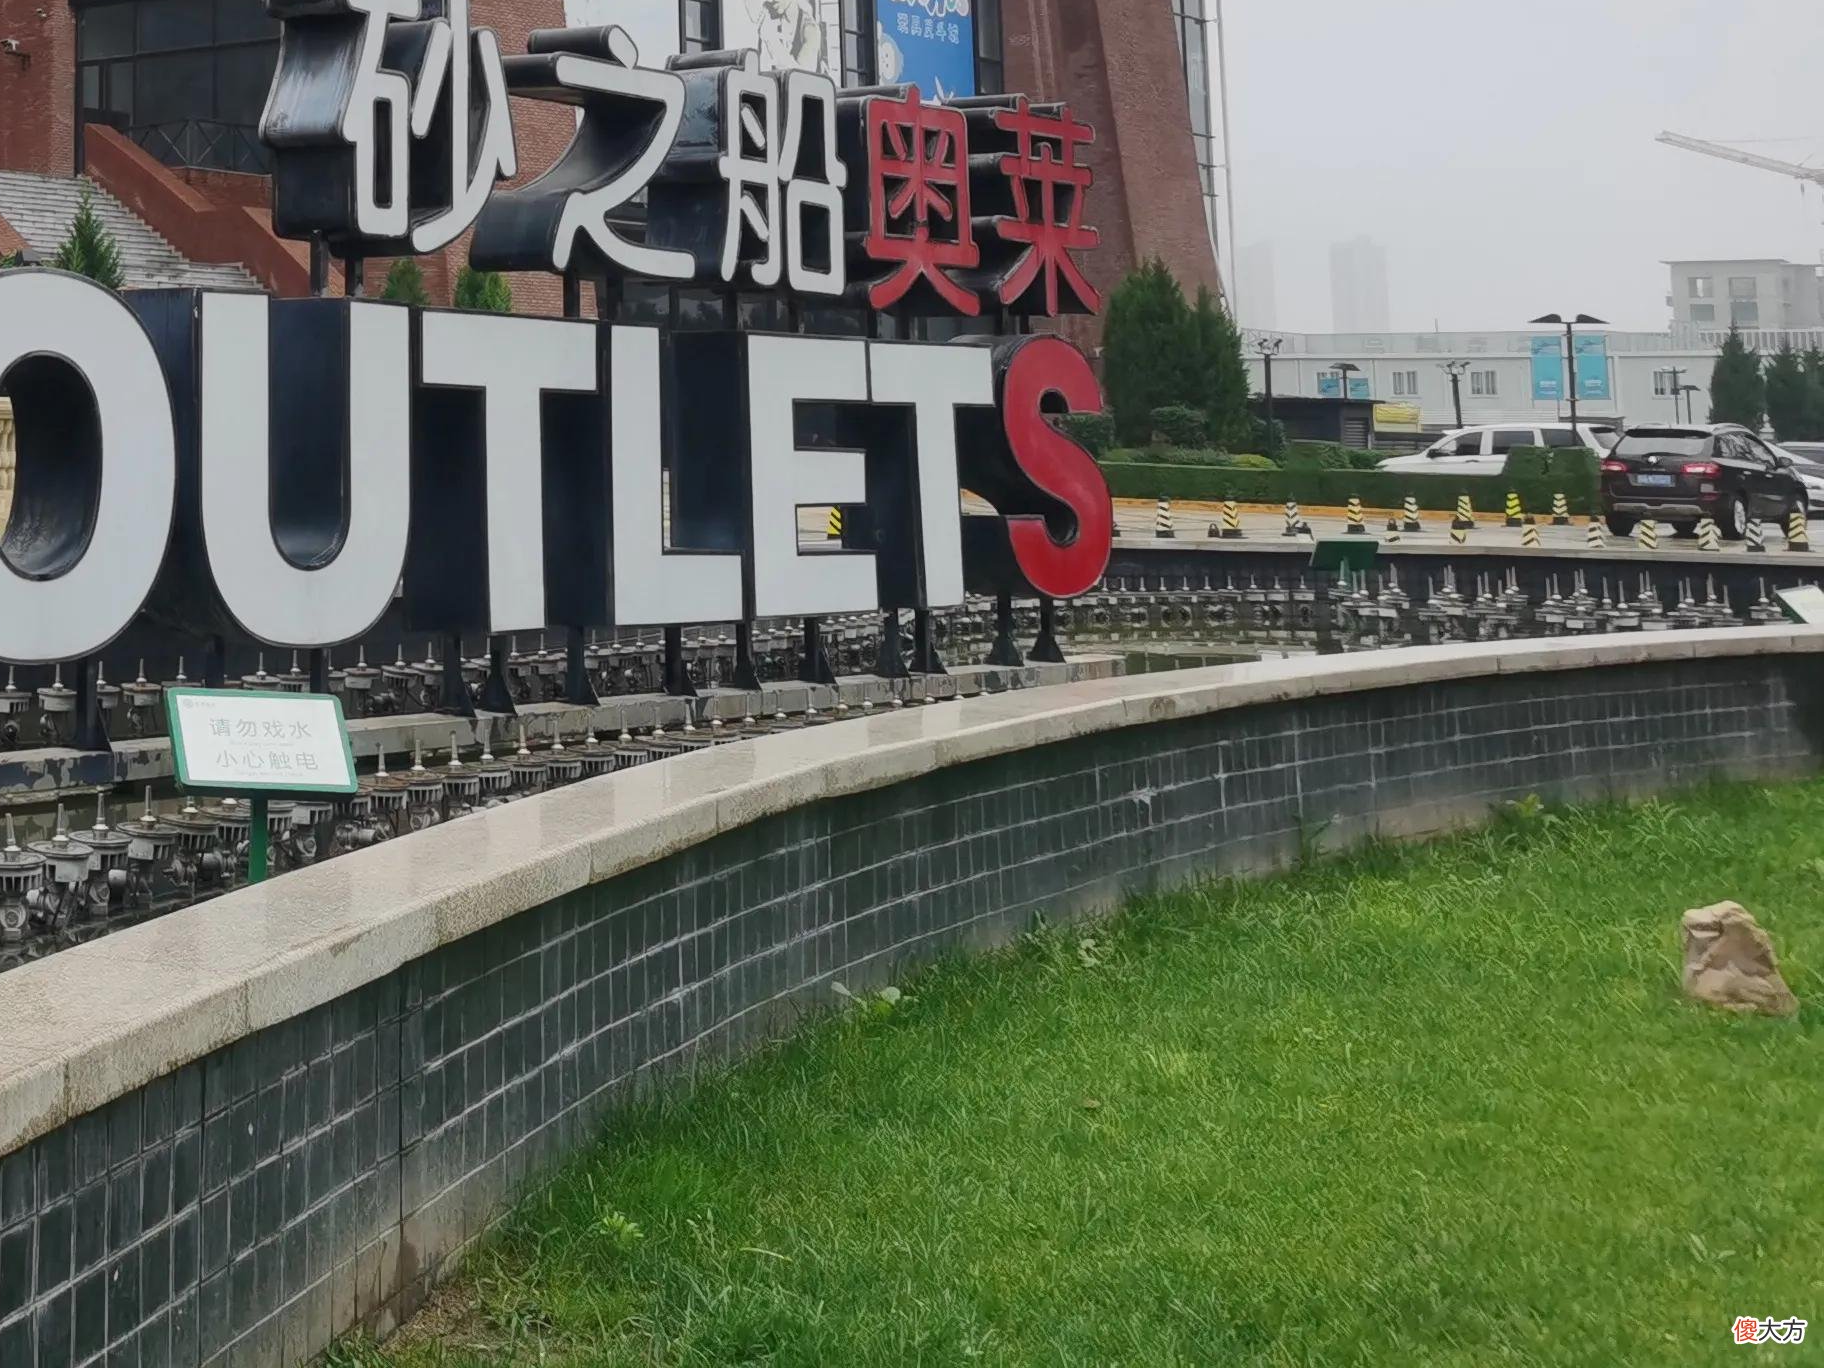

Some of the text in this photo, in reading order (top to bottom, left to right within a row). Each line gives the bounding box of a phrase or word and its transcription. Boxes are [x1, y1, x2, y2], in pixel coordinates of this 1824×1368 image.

[209, 717, 312, 740] 请勿戏水
[216, 750, 319, 771] 小心触电
